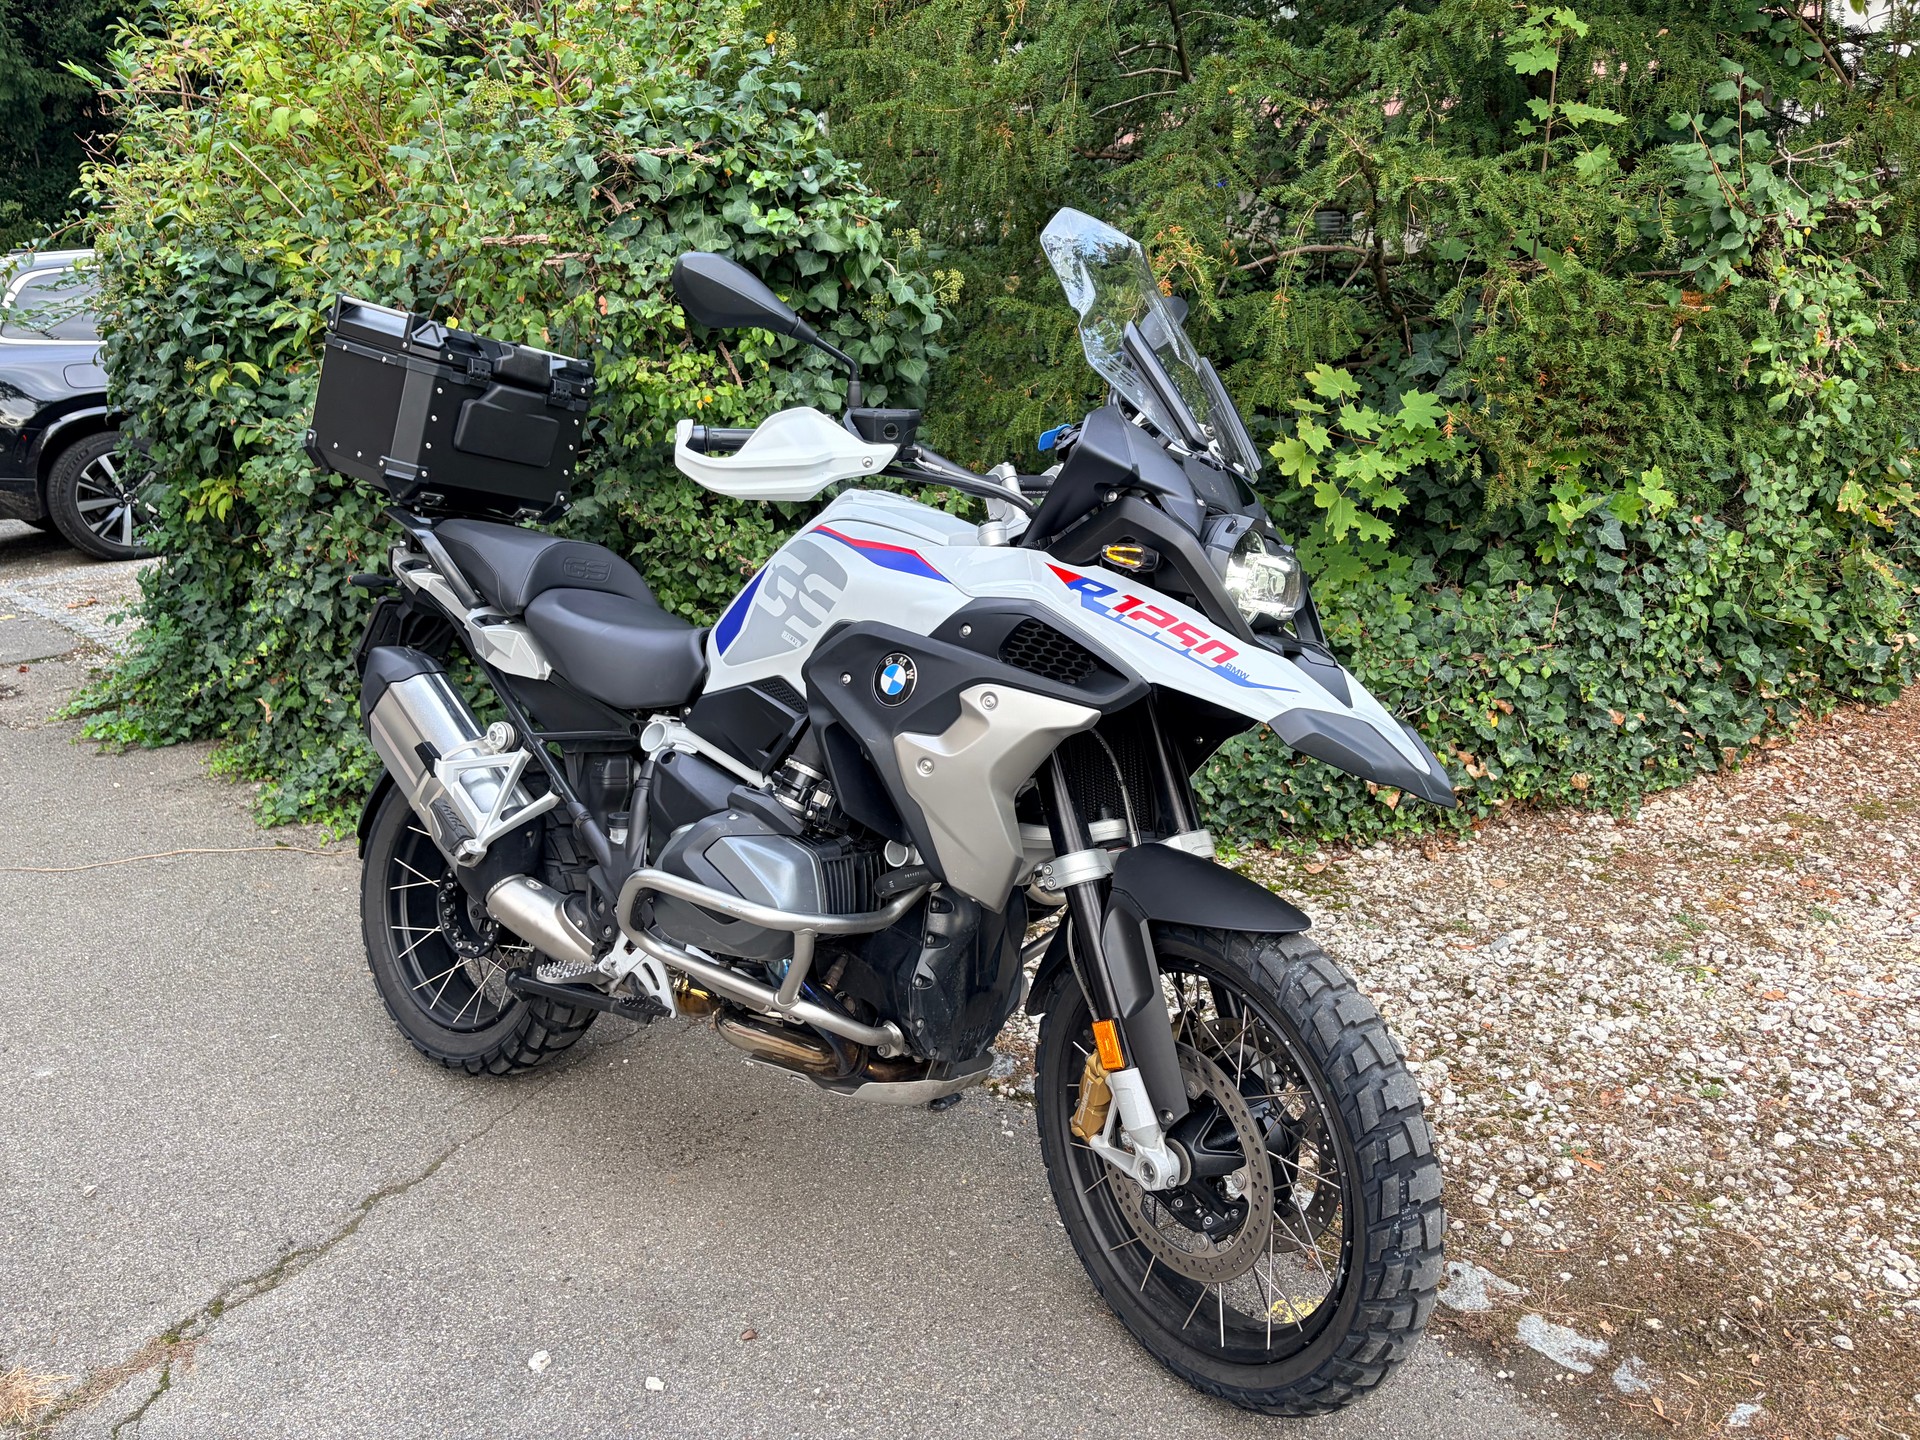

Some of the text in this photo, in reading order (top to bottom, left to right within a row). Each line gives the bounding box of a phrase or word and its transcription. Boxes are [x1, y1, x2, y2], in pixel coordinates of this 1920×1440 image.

[563, 556, 612, 582] GS
[756, 551, 843, 641] GS
[885, 656, 915, 680] BMW
[1225, 662, 1250, 680] BMW
